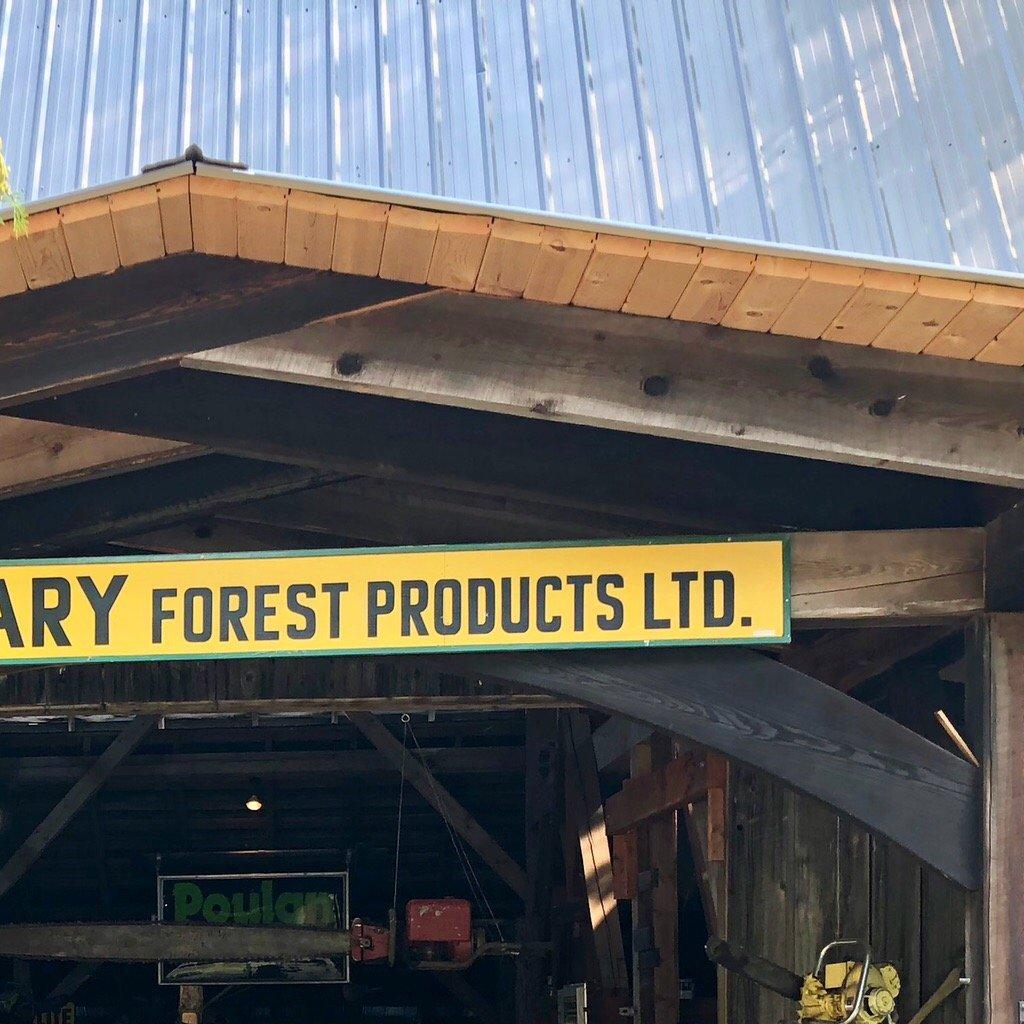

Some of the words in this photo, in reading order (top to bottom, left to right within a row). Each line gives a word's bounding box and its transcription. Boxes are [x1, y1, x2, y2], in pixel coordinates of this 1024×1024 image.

[151, 582, 349, 643] FOREST
[367, 573, 624, 638] PRODUCTS
[644, 570, 752, 630] LTD.
[174, 880, 337, 926] Poulan
